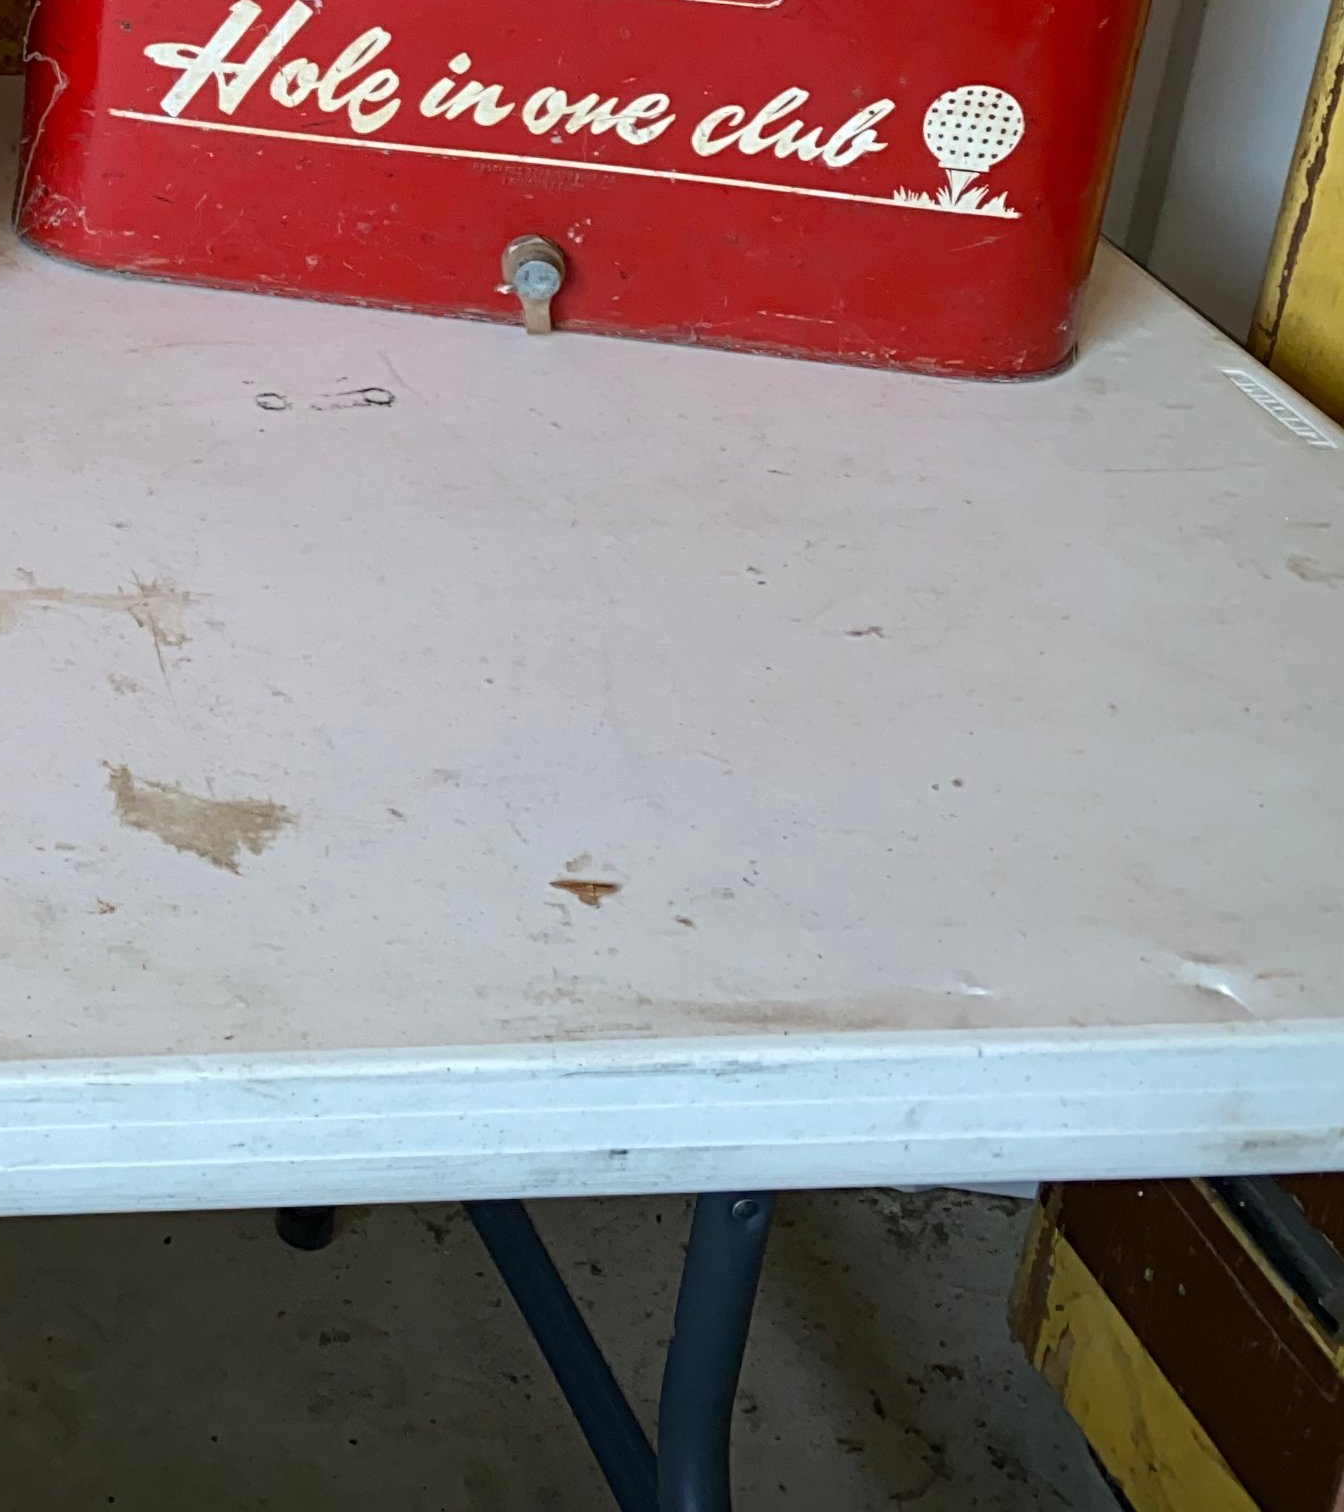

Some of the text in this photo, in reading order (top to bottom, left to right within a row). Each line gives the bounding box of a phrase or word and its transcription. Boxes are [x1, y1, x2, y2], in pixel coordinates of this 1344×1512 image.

[419, 53, 514, 128] in
[522, 87, 676, 145] one
[690, 86, 895, 170] club
